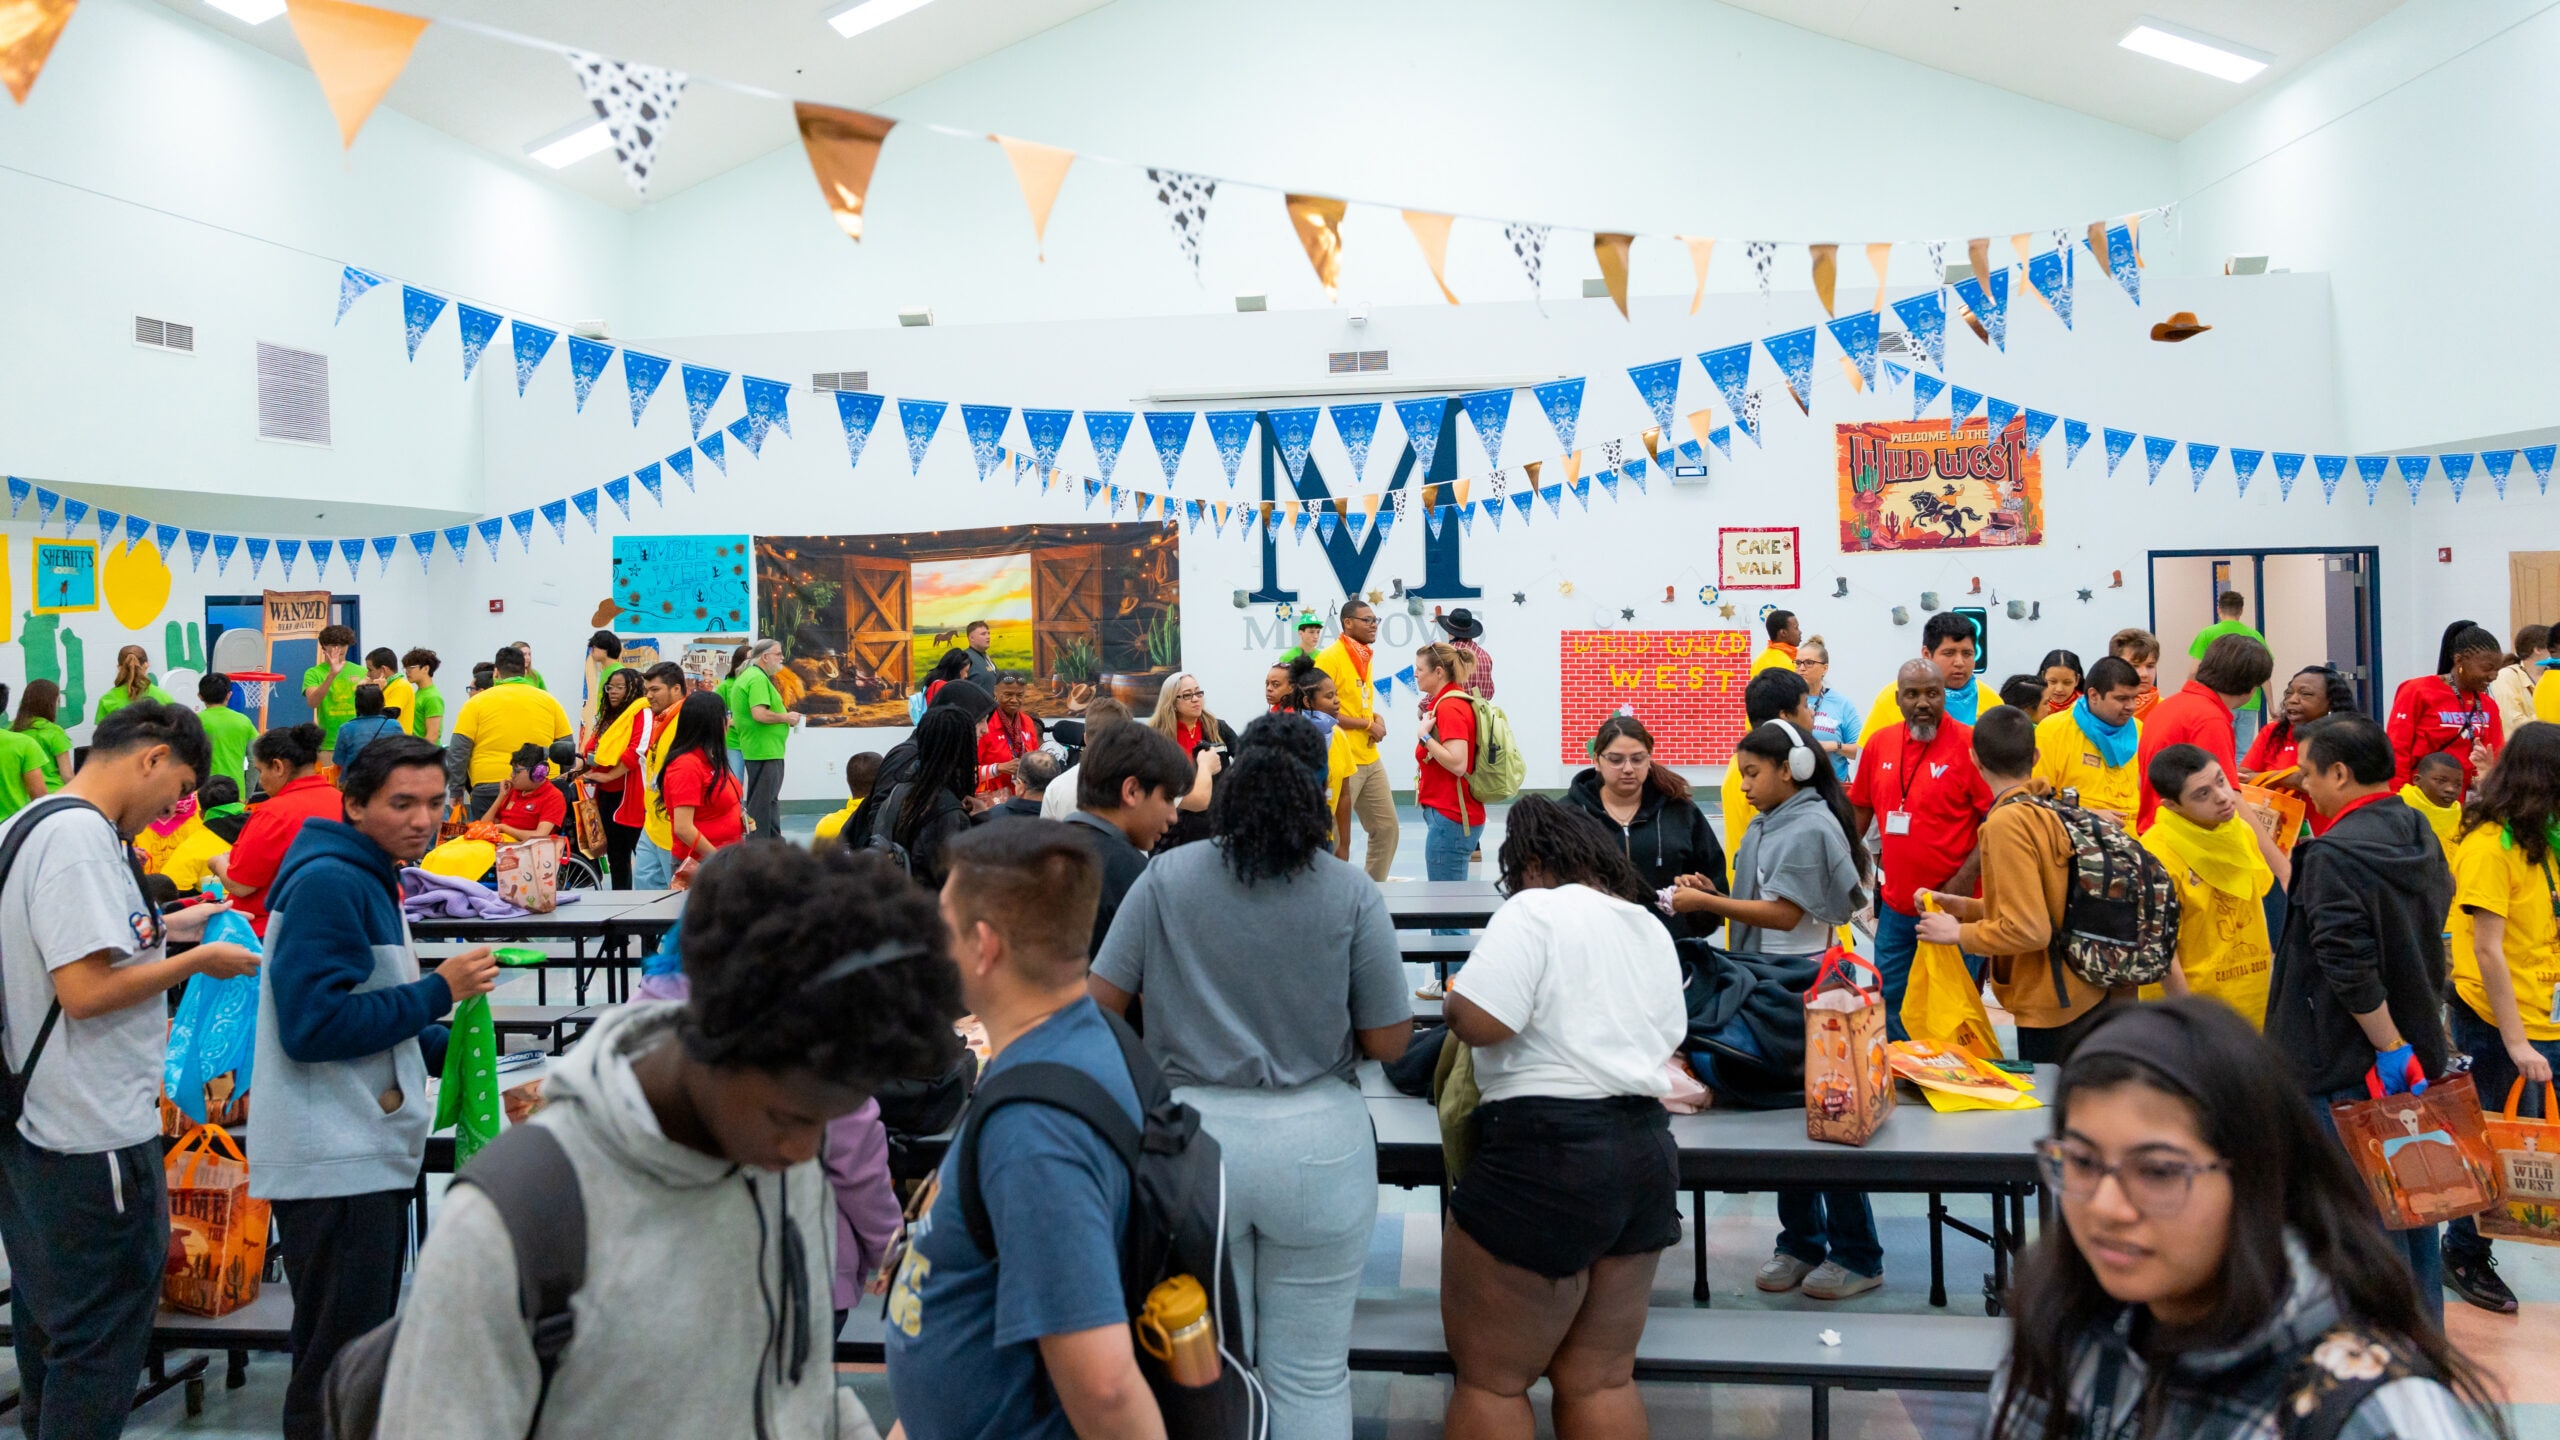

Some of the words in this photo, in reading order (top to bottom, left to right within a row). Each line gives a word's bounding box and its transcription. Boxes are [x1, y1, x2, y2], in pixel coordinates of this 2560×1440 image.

[1890, 430, 1947, 444] WELCOME
[1966, 429, 1989, 441] THE
[1850, 435, 1932, 494] WILD
[1935, 428, 2027, 492] WEST
[621, 539, 708, 562] TUMBLE
[1736, 539, 1781, 555] CAKE
[1736, 561, 1782, 575] WALK
[674, 578, 738, 606] TOSS
[270, 600, 327, 621] WANTED
[1574, 634, 1650, 653] WILD
[1664, 632, 1747, 656] WILD
[718, 655, 731, 664] WIL
[1609, 664, 1735, 693] WEST
[1930, 762, 1949, 779] W
[2513, 1166, 2553, 1179] WILD
[2514, 1178, 2554, 1192] WEST
